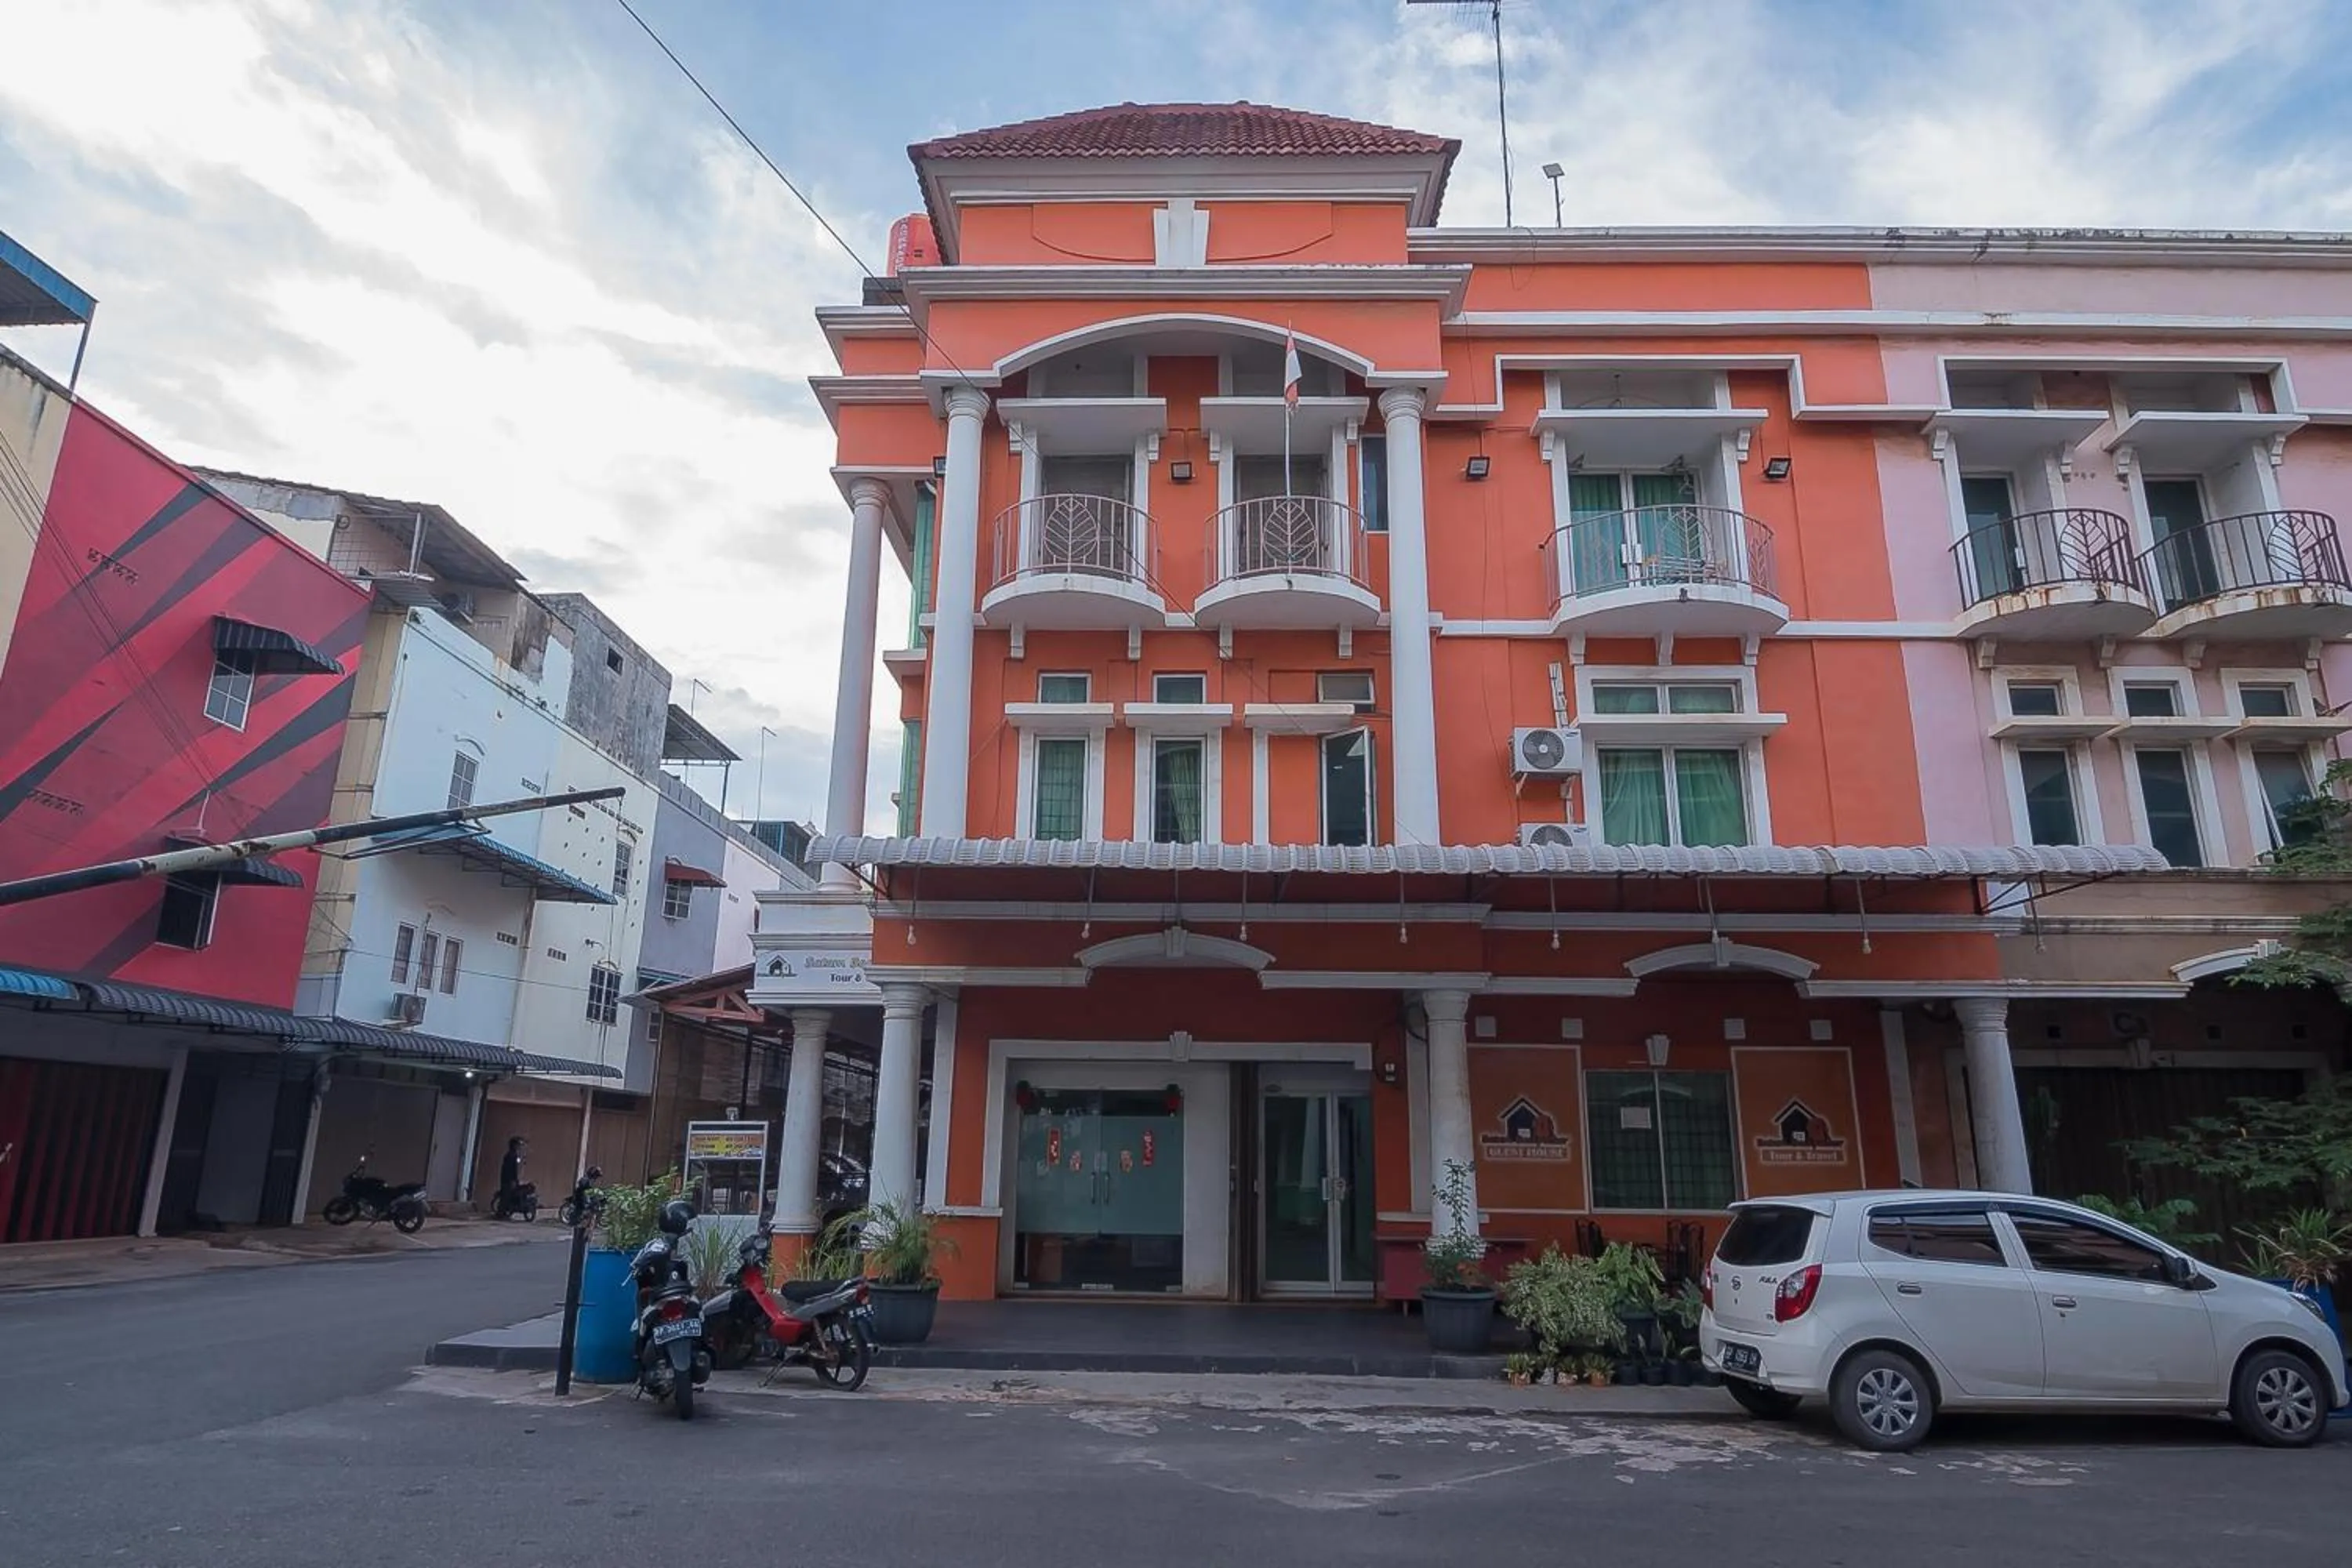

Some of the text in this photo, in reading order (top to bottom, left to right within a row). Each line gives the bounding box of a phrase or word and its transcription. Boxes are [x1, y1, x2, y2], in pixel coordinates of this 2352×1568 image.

[830, 973, 853, 982] Tour
[1488, 1148, 1563, 1157] GUEST HOUSE
